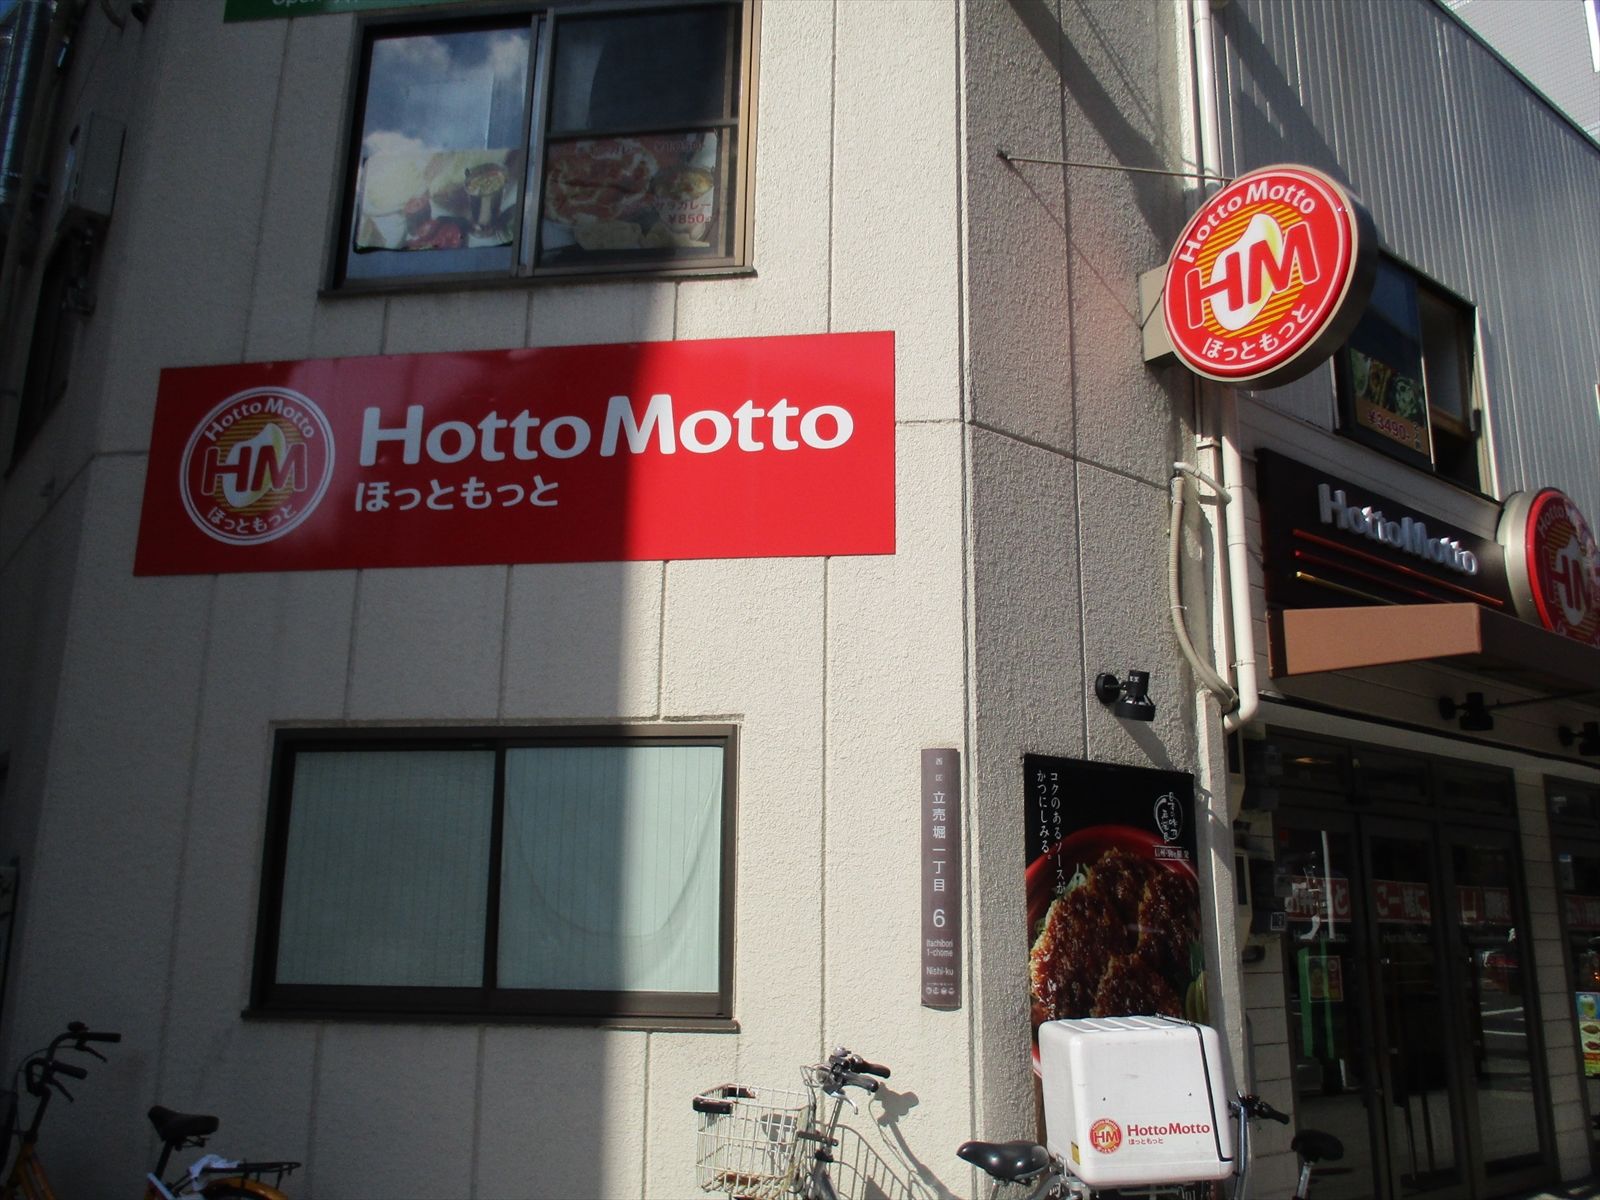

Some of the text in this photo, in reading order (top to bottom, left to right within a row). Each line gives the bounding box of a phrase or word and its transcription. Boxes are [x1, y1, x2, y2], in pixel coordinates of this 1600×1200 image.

[1201, 303, 1314, 361] ほっともっと
[354, 474, 559, 512] ほっともっと
[207, 506, 297, 534] ほっともっと
[933, 908, 946, 928] 6
